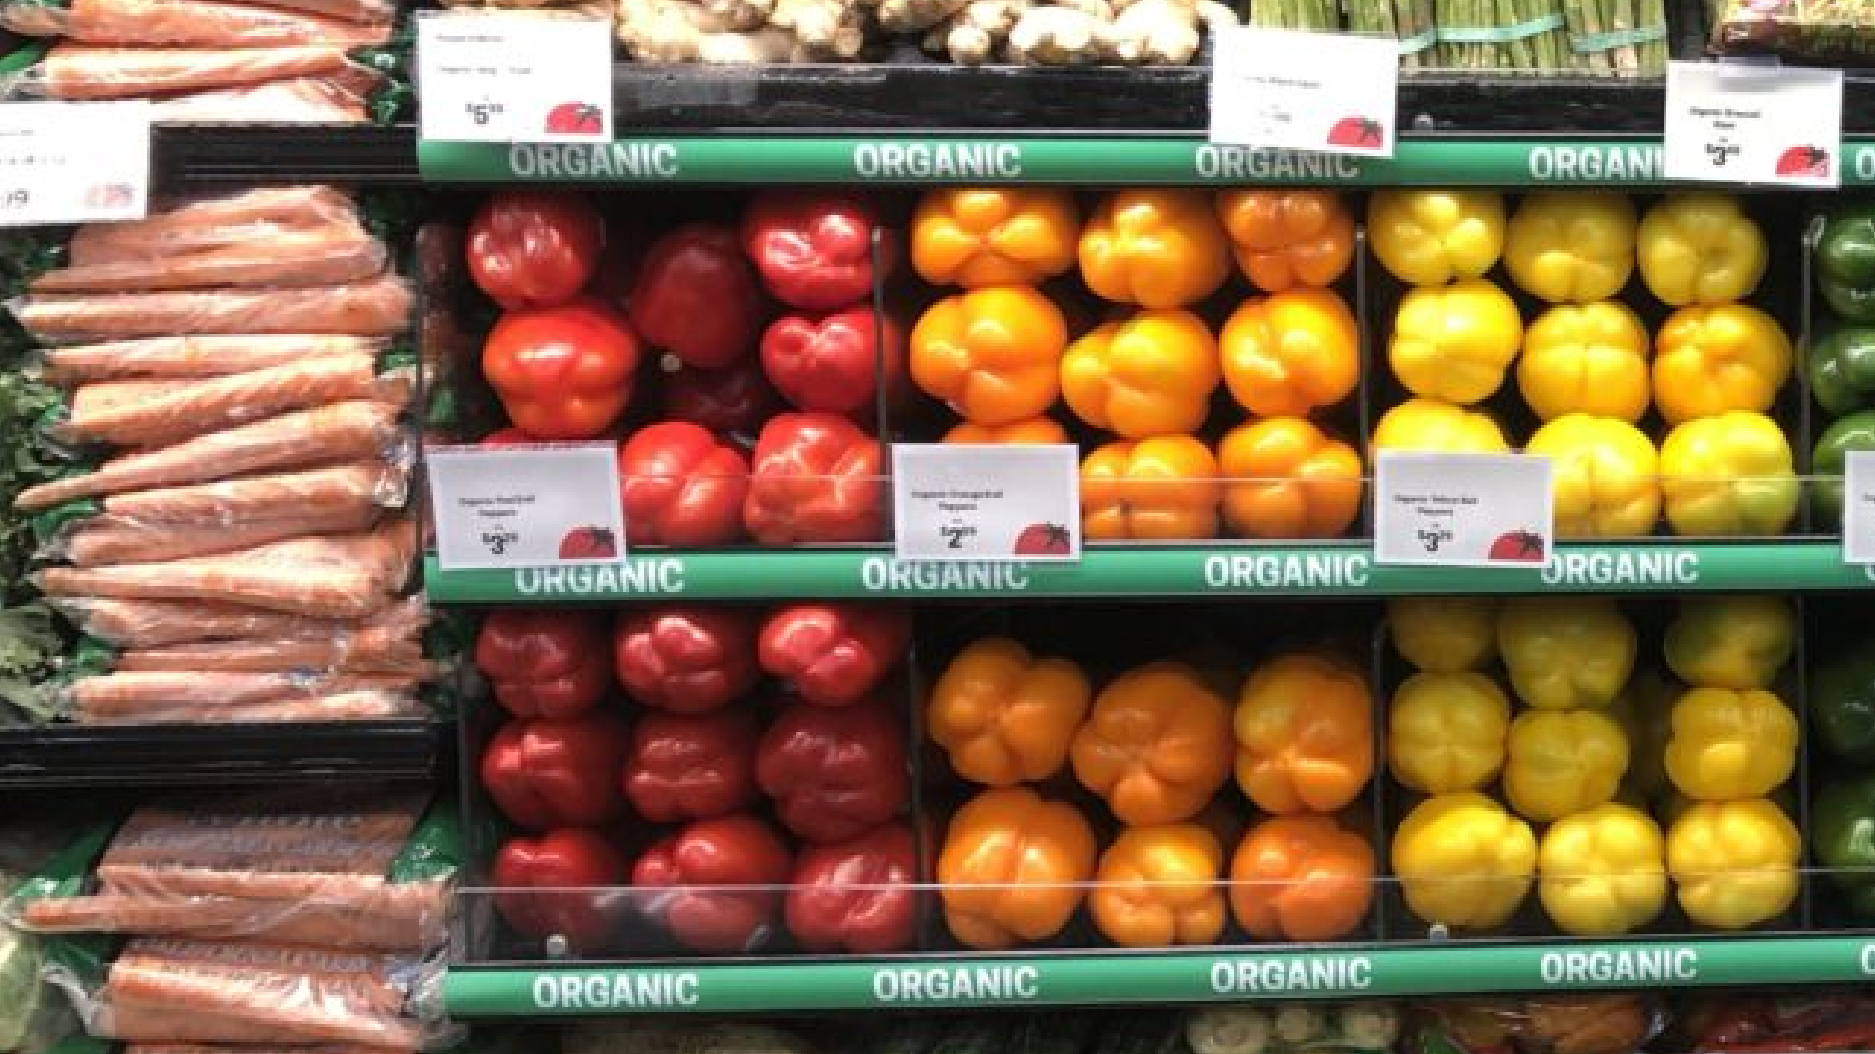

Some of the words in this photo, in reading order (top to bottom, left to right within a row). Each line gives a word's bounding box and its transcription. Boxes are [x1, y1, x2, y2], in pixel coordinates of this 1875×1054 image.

[509, 144, 677, 178] ORGANIC
[855, 143, 1021, 178] ORGANIC
[1194, 145, 1361, 180] ORGANIC
[1528, 145, 1664, 179] ORGANI
[516, 560, 684, 593] ORGANIC
[861, 558, 1028, 590] ORGANIC
[1203, 553, 1367, 587] ORGANIC
[1540, 552, 1698, 584] ORGANIC
[1210, 955, 1371, 992] ORGANIC
[1539, 947, 1698, 984] ORGANIC
[533, 973, 699, 1009] ORGANIC
[872, 966, 1038, 1002] ORGANIC
